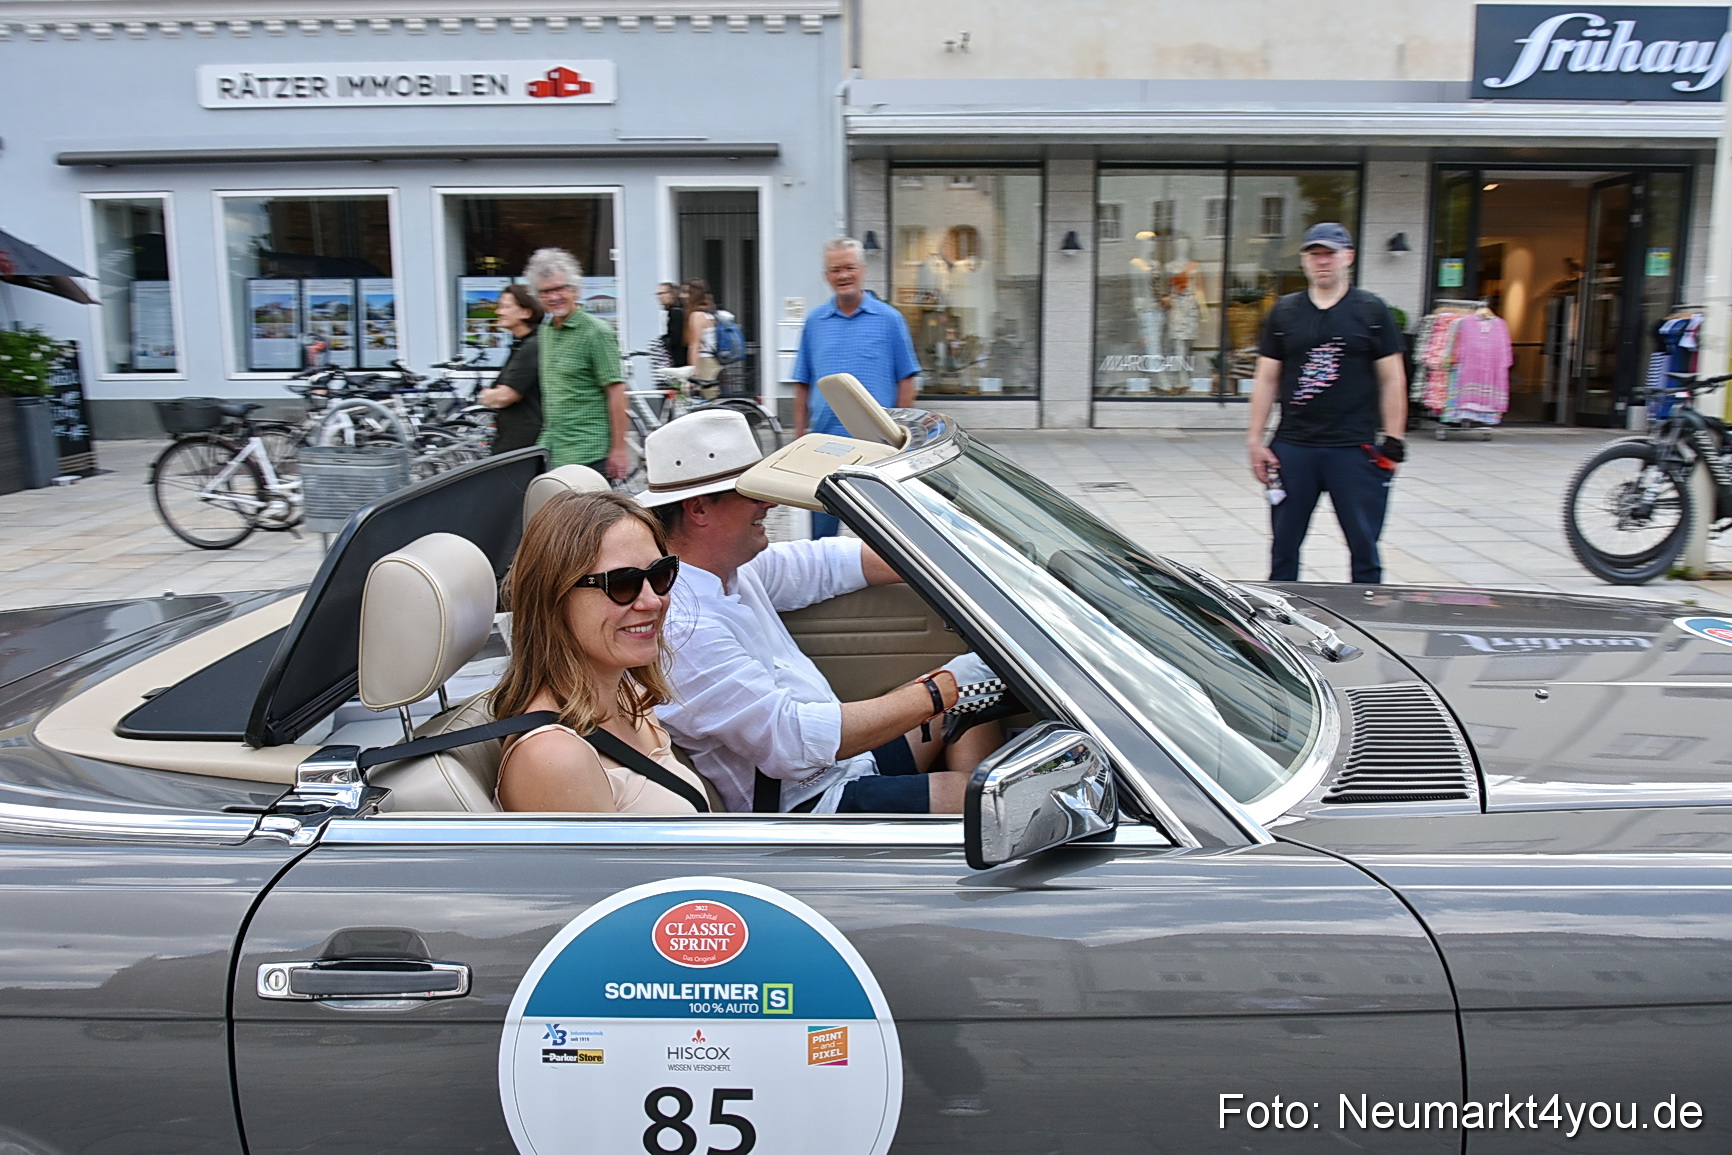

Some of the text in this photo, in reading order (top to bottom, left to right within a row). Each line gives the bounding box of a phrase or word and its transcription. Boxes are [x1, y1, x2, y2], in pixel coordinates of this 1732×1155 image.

[216, 72, 510, 101] RÄTZER IMMOBILIEN
[664, 922, 737, 936] CLASSIC
[669, 937, 731, 951] SPRINT
[682, 954, 717, 963] Das Original
[604, 982, 759, 1001] SONNLEITNER
[725, 1003, 760, 1014] AUTO
[812, 1031, 843, 1044] PRINT
[820, 1040, 836, 1050] and
[667, 1046, 731, 1060] HISCOX
[812, 1048, 843, 1061] PIXEL
[667, 1063, 692, 1071] WISSEN
[643, 1086, 756, 1155] 85
